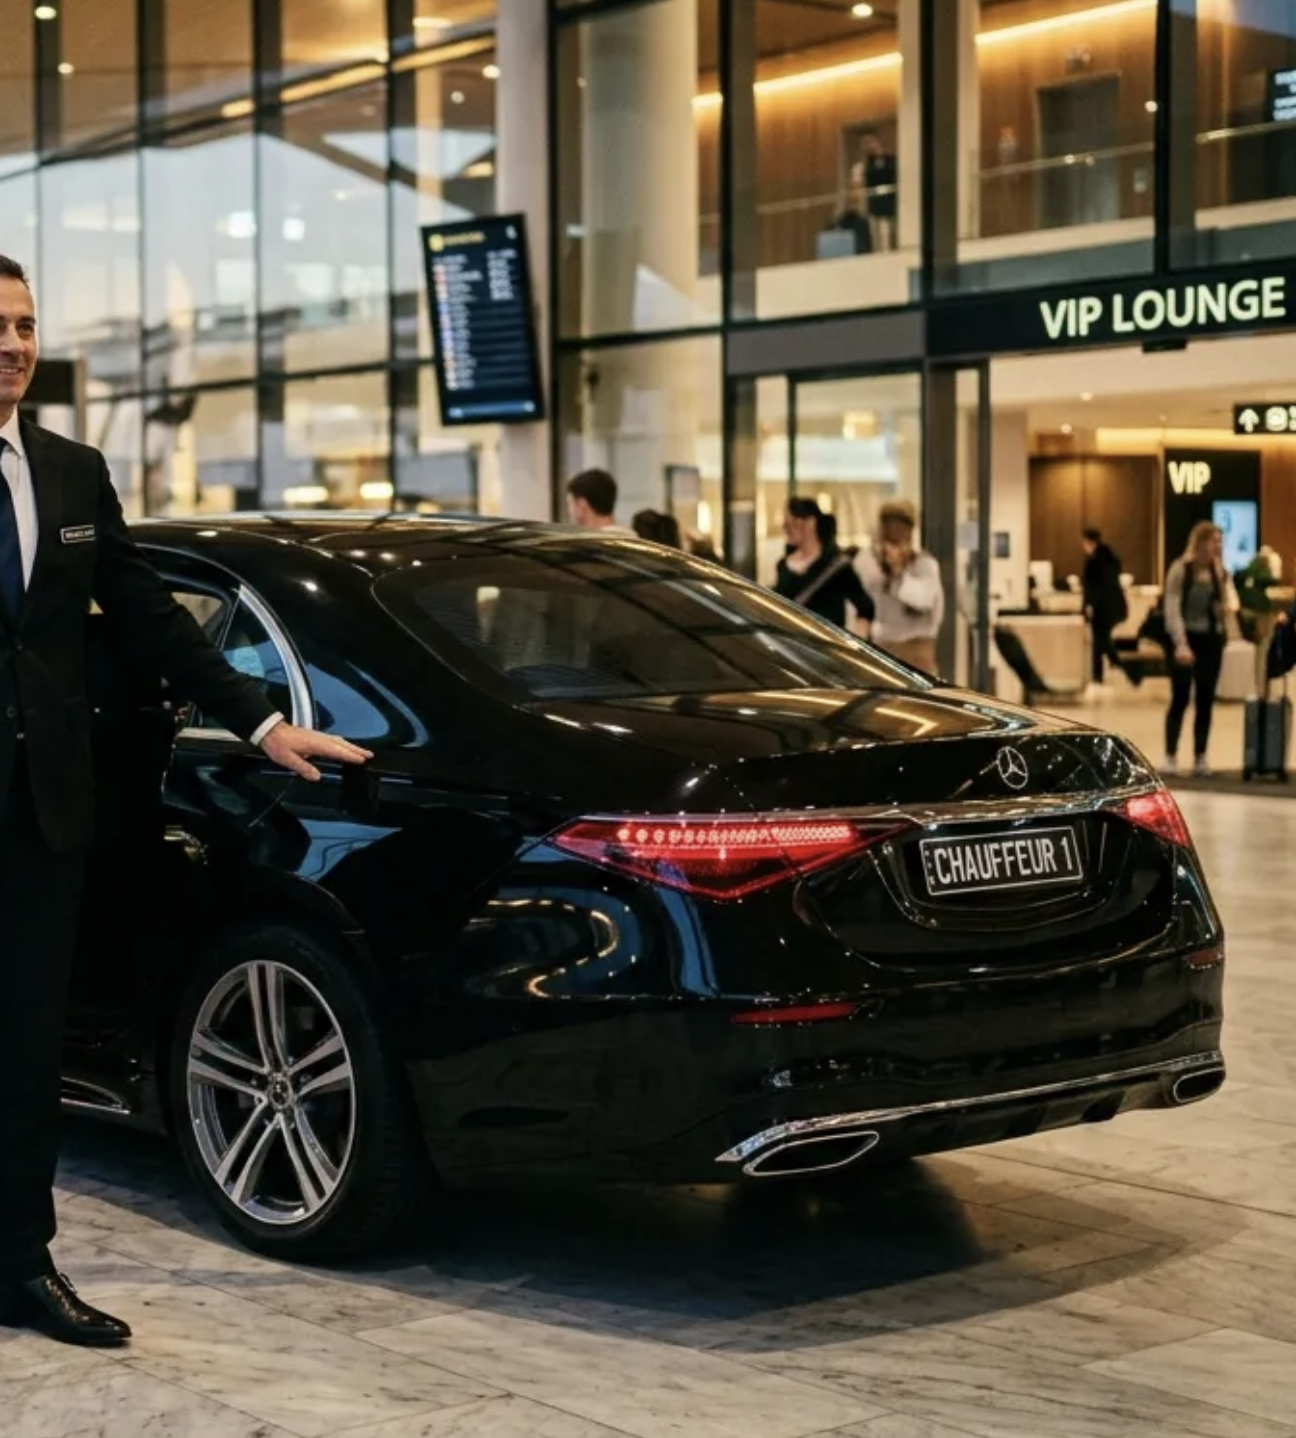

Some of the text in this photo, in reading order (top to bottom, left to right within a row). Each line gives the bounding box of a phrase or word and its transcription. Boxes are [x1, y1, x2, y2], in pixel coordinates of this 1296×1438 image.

[1039, 276, 1286, 339] VIP LOUNGE
[1167, 461, 1211, 494] VIP
[934, 837, 1058, 885] CHAUFFEUR
[1060, 836, 1073, 871] 1
